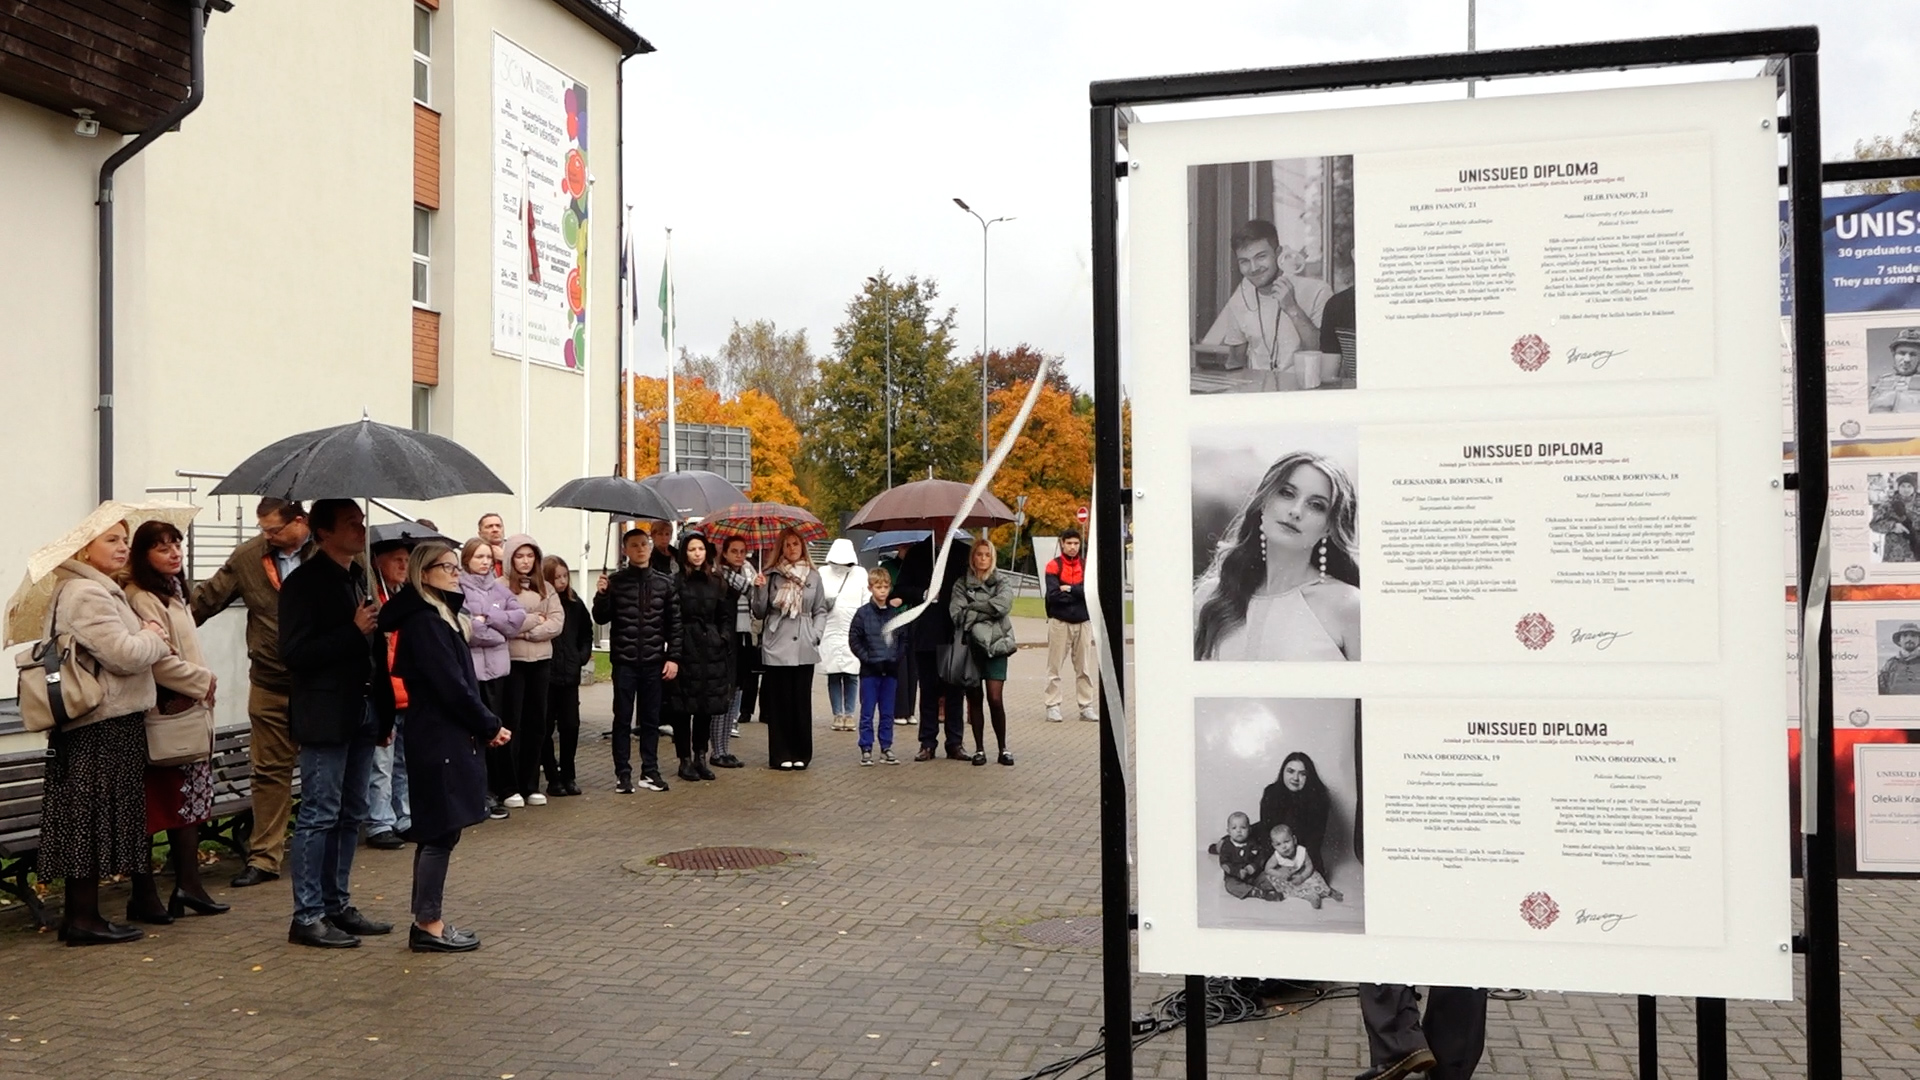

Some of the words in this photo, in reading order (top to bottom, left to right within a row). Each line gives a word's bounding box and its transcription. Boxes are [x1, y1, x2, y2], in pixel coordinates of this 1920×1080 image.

[1459, 166, 1528, 183] UNISSUED
[1838, 248, 1852, 257] 30
[1854, 246, 1912, 259] graduates
[1877, 266, 1884, 275] 7
[1832, 278, 1860, 288] They
[1862, 277, 1881, 286] are
[1883, 275, 1914, 284] some
[1826, 364, 1858, 372] tsukon
[1463, 444, 1532, 458] UNISSUED
[1467, 722, 1536, 735] UNISSUED
